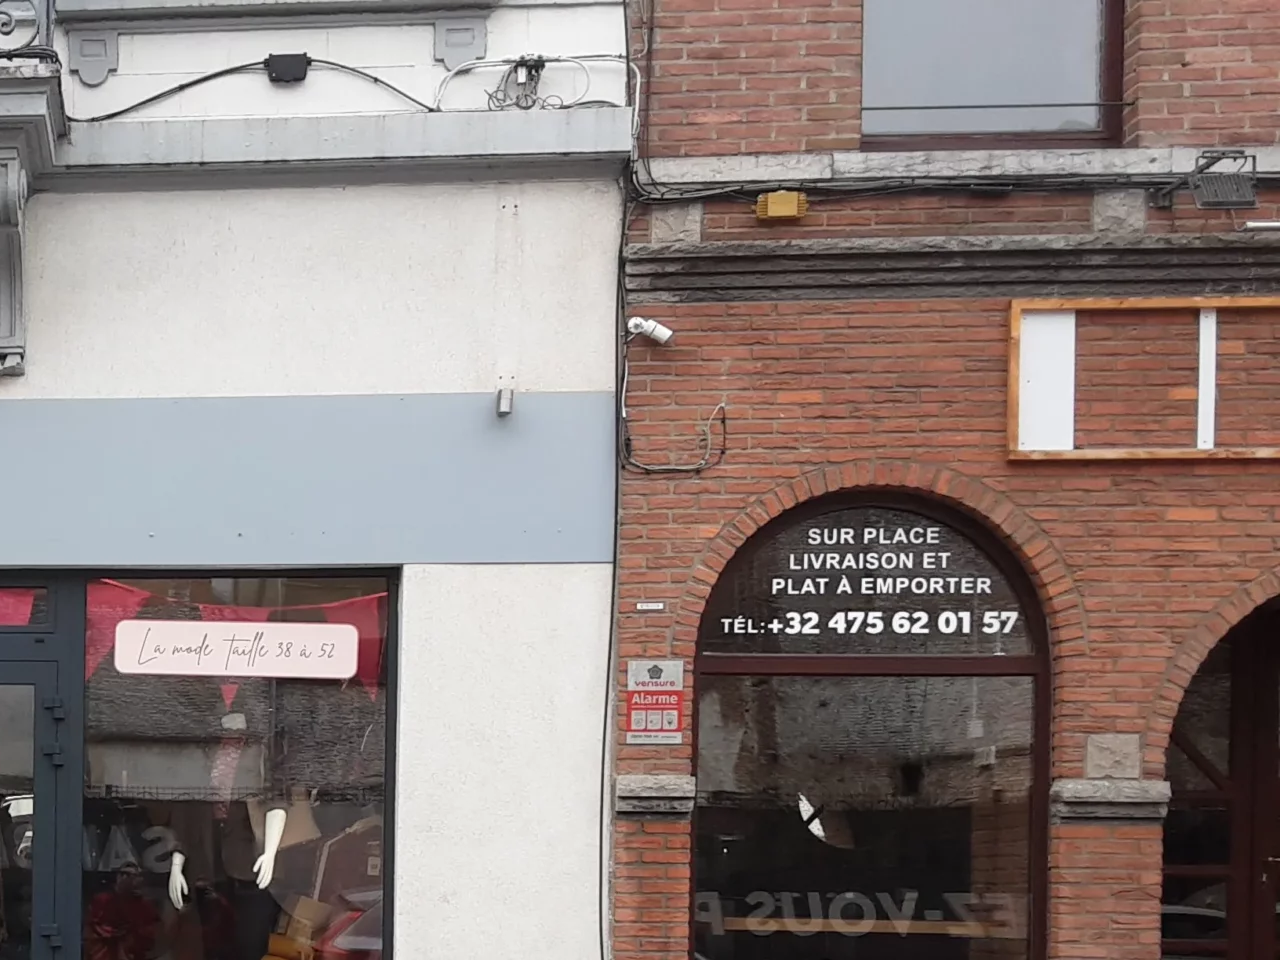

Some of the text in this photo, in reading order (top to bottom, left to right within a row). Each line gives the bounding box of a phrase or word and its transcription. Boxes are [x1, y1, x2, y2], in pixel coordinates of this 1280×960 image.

[808, 527, 940, 545] SUR PLACE
[789, 552, 951, 570] LIVRAISON ET
[771, 574, 992, 595] PLAT À EMPORTER
[828, 612, 884, 634] 475
[892, 611, 929, 634] 62
[937, 611, 971, 633] 01
[981, 611, 1018, 633] 57
[137, 627, 166, 665] La
[172, 633, 213, 666] mode
[275, 641, 294, 658] 38
[299, 643, 312, 658] à
[317, 641, 335, 659] 52
[631, 692, 678, 704] Alarme
